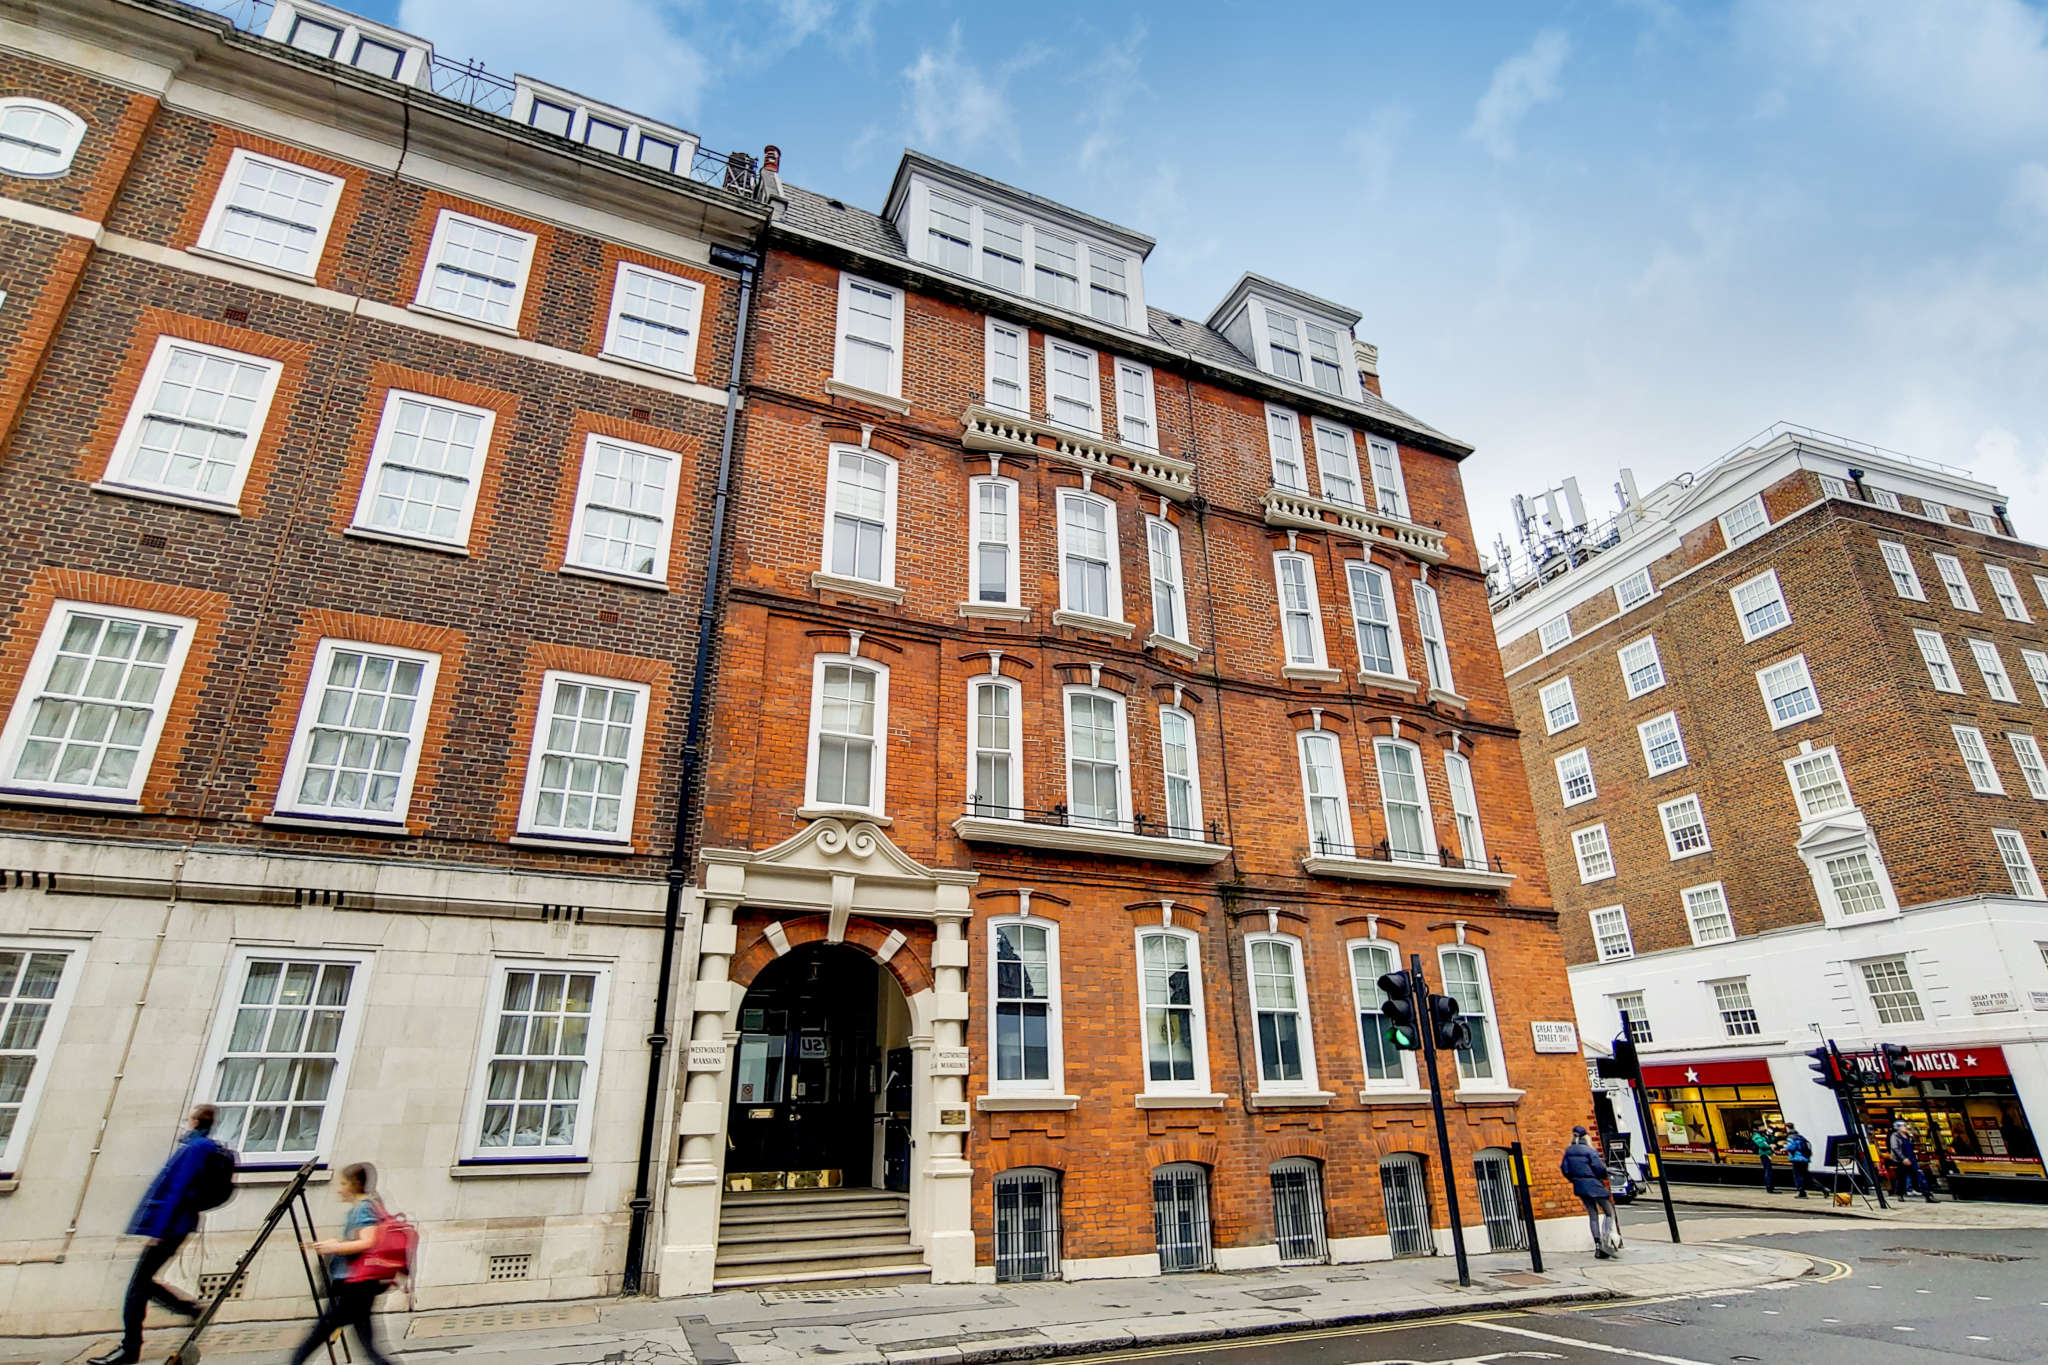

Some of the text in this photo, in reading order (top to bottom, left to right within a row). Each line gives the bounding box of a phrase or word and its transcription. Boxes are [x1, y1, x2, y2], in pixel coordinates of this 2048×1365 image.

[1536, 1024, 1572, 1033] GREAT SMITH
[1537, 1034, 1557, 1042] STREET
[1857, 1056, 1886, 1073] PRET
